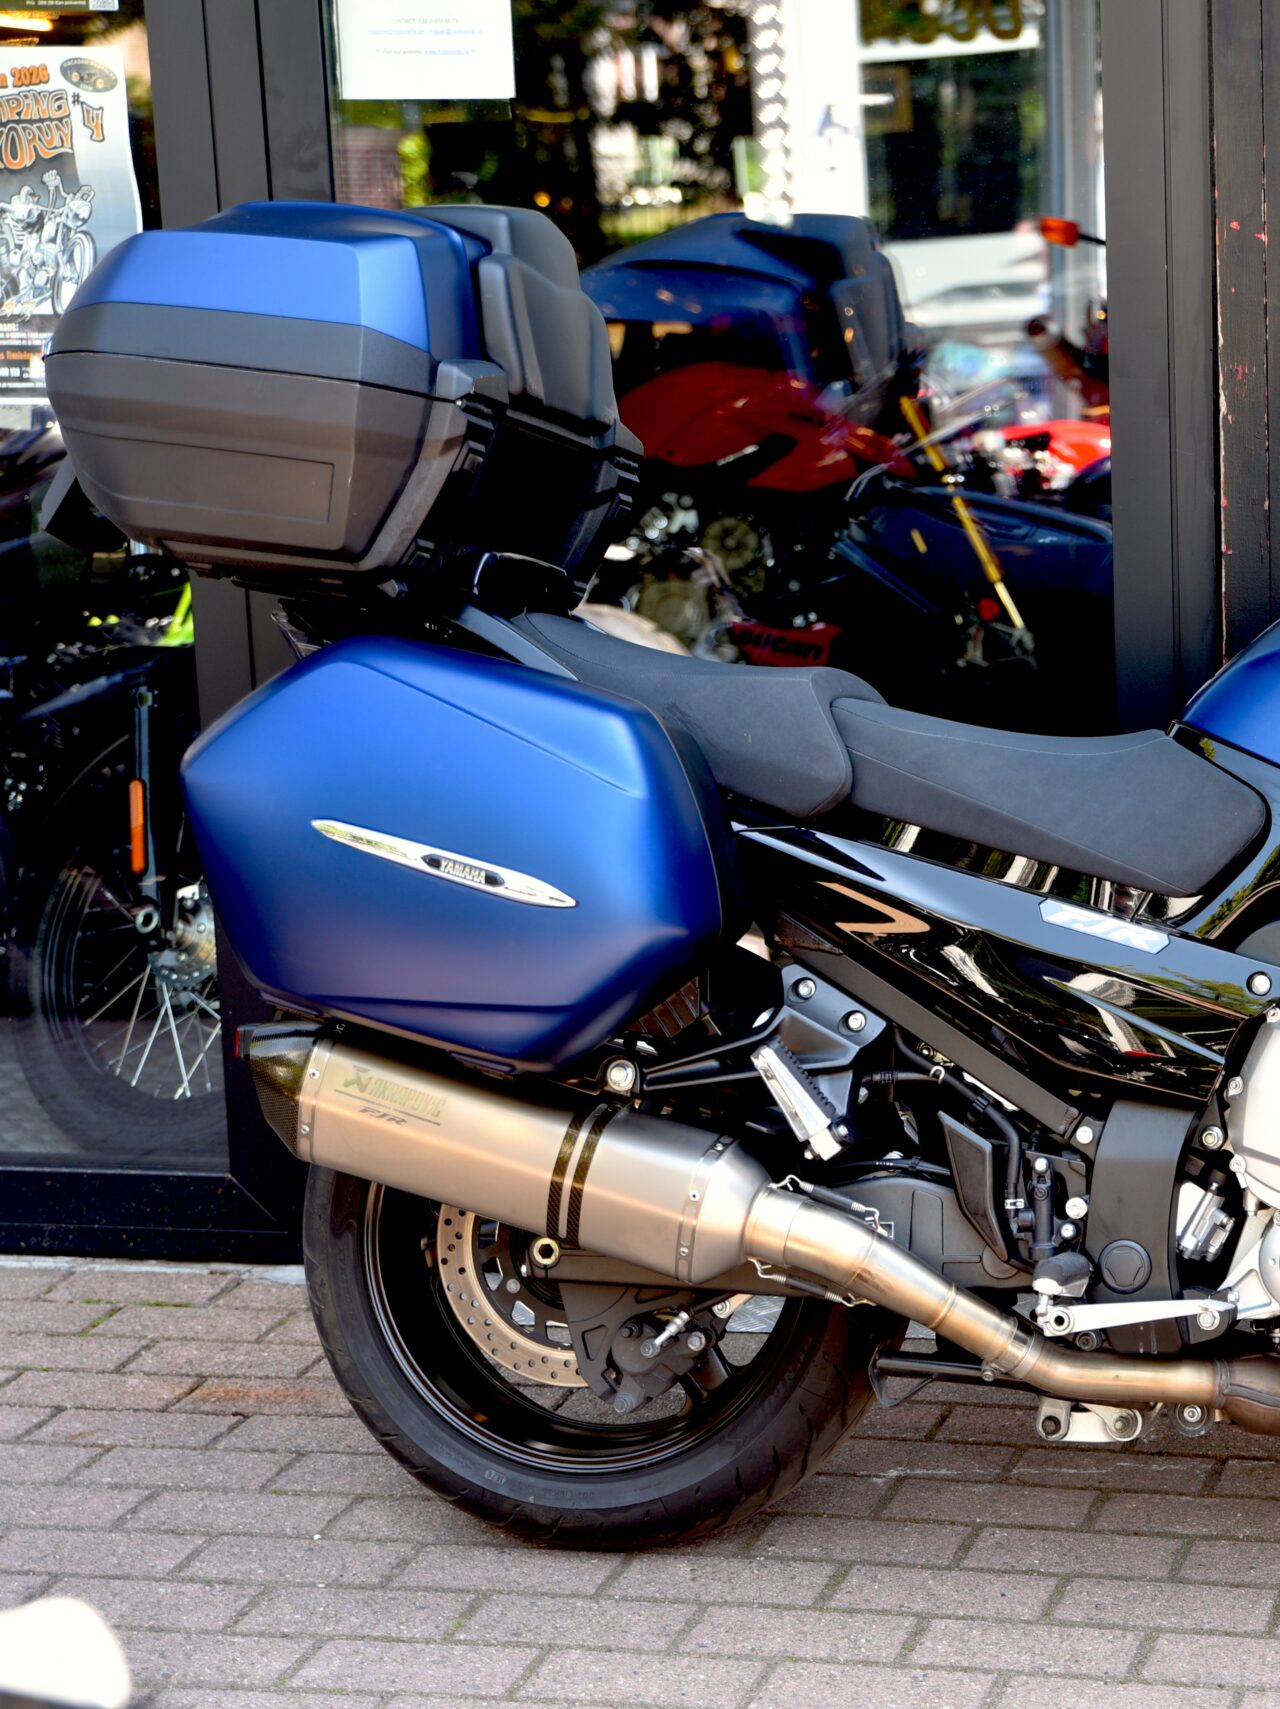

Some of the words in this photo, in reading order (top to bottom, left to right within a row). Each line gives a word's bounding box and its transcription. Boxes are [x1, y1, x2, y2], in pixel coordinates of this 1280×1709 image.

[11, 64, 49, 88] 2026
[0, 89, 71, 122] PING
[0, 119, 73, 170] ORUN
[439, 858, 486, 884] YAMAHA
[1046, 903, 1163, 949] FJR
[358, 1105, 408, 1126] FJR
